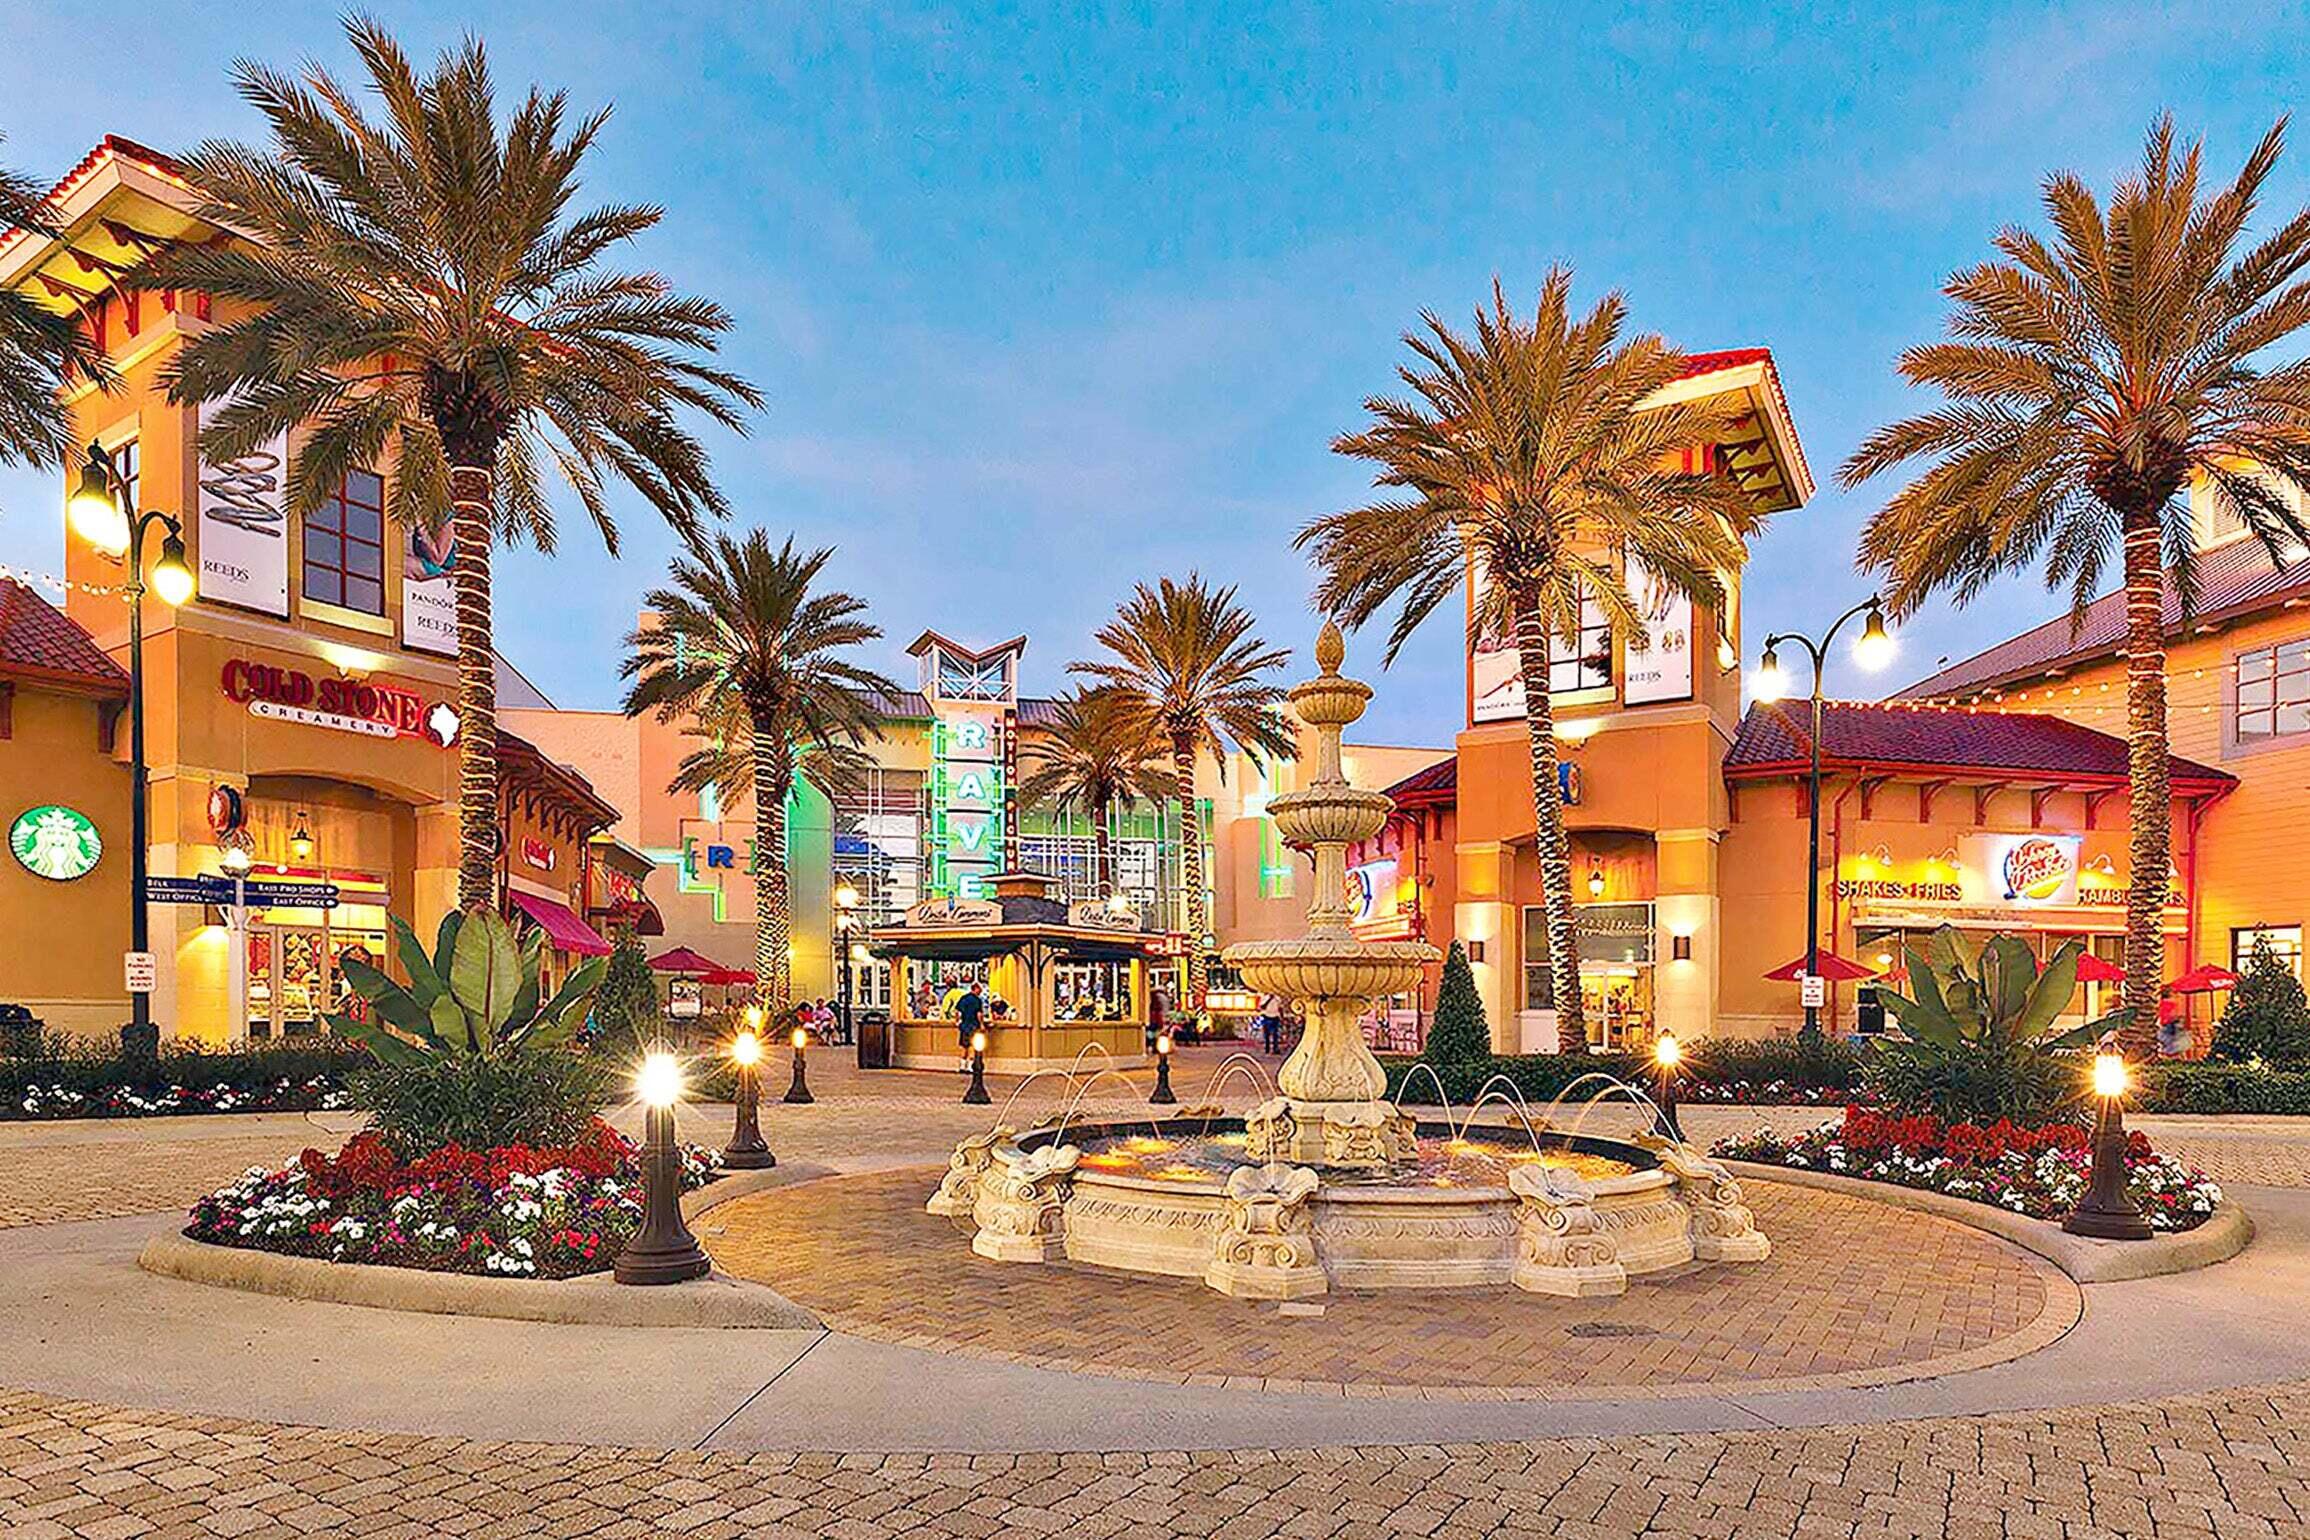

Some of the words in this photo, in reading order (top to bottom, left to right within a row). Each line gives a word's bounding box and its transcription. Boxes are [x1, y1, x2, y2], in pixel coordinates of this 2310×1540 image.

[203, 560, 249, 580] REEDS
[221, 658, 314, 704] COLD
[317, 678, 421, 732] STONE
[258, 703, 392, 736] CREAMERY
[955, 720, 987, 900] RAVE
[1005, 800, 1018, 874] PICTUR
[1838, 879, 1904, 899] SHAKES
[1916, 882, 1962, 901] FRIES
